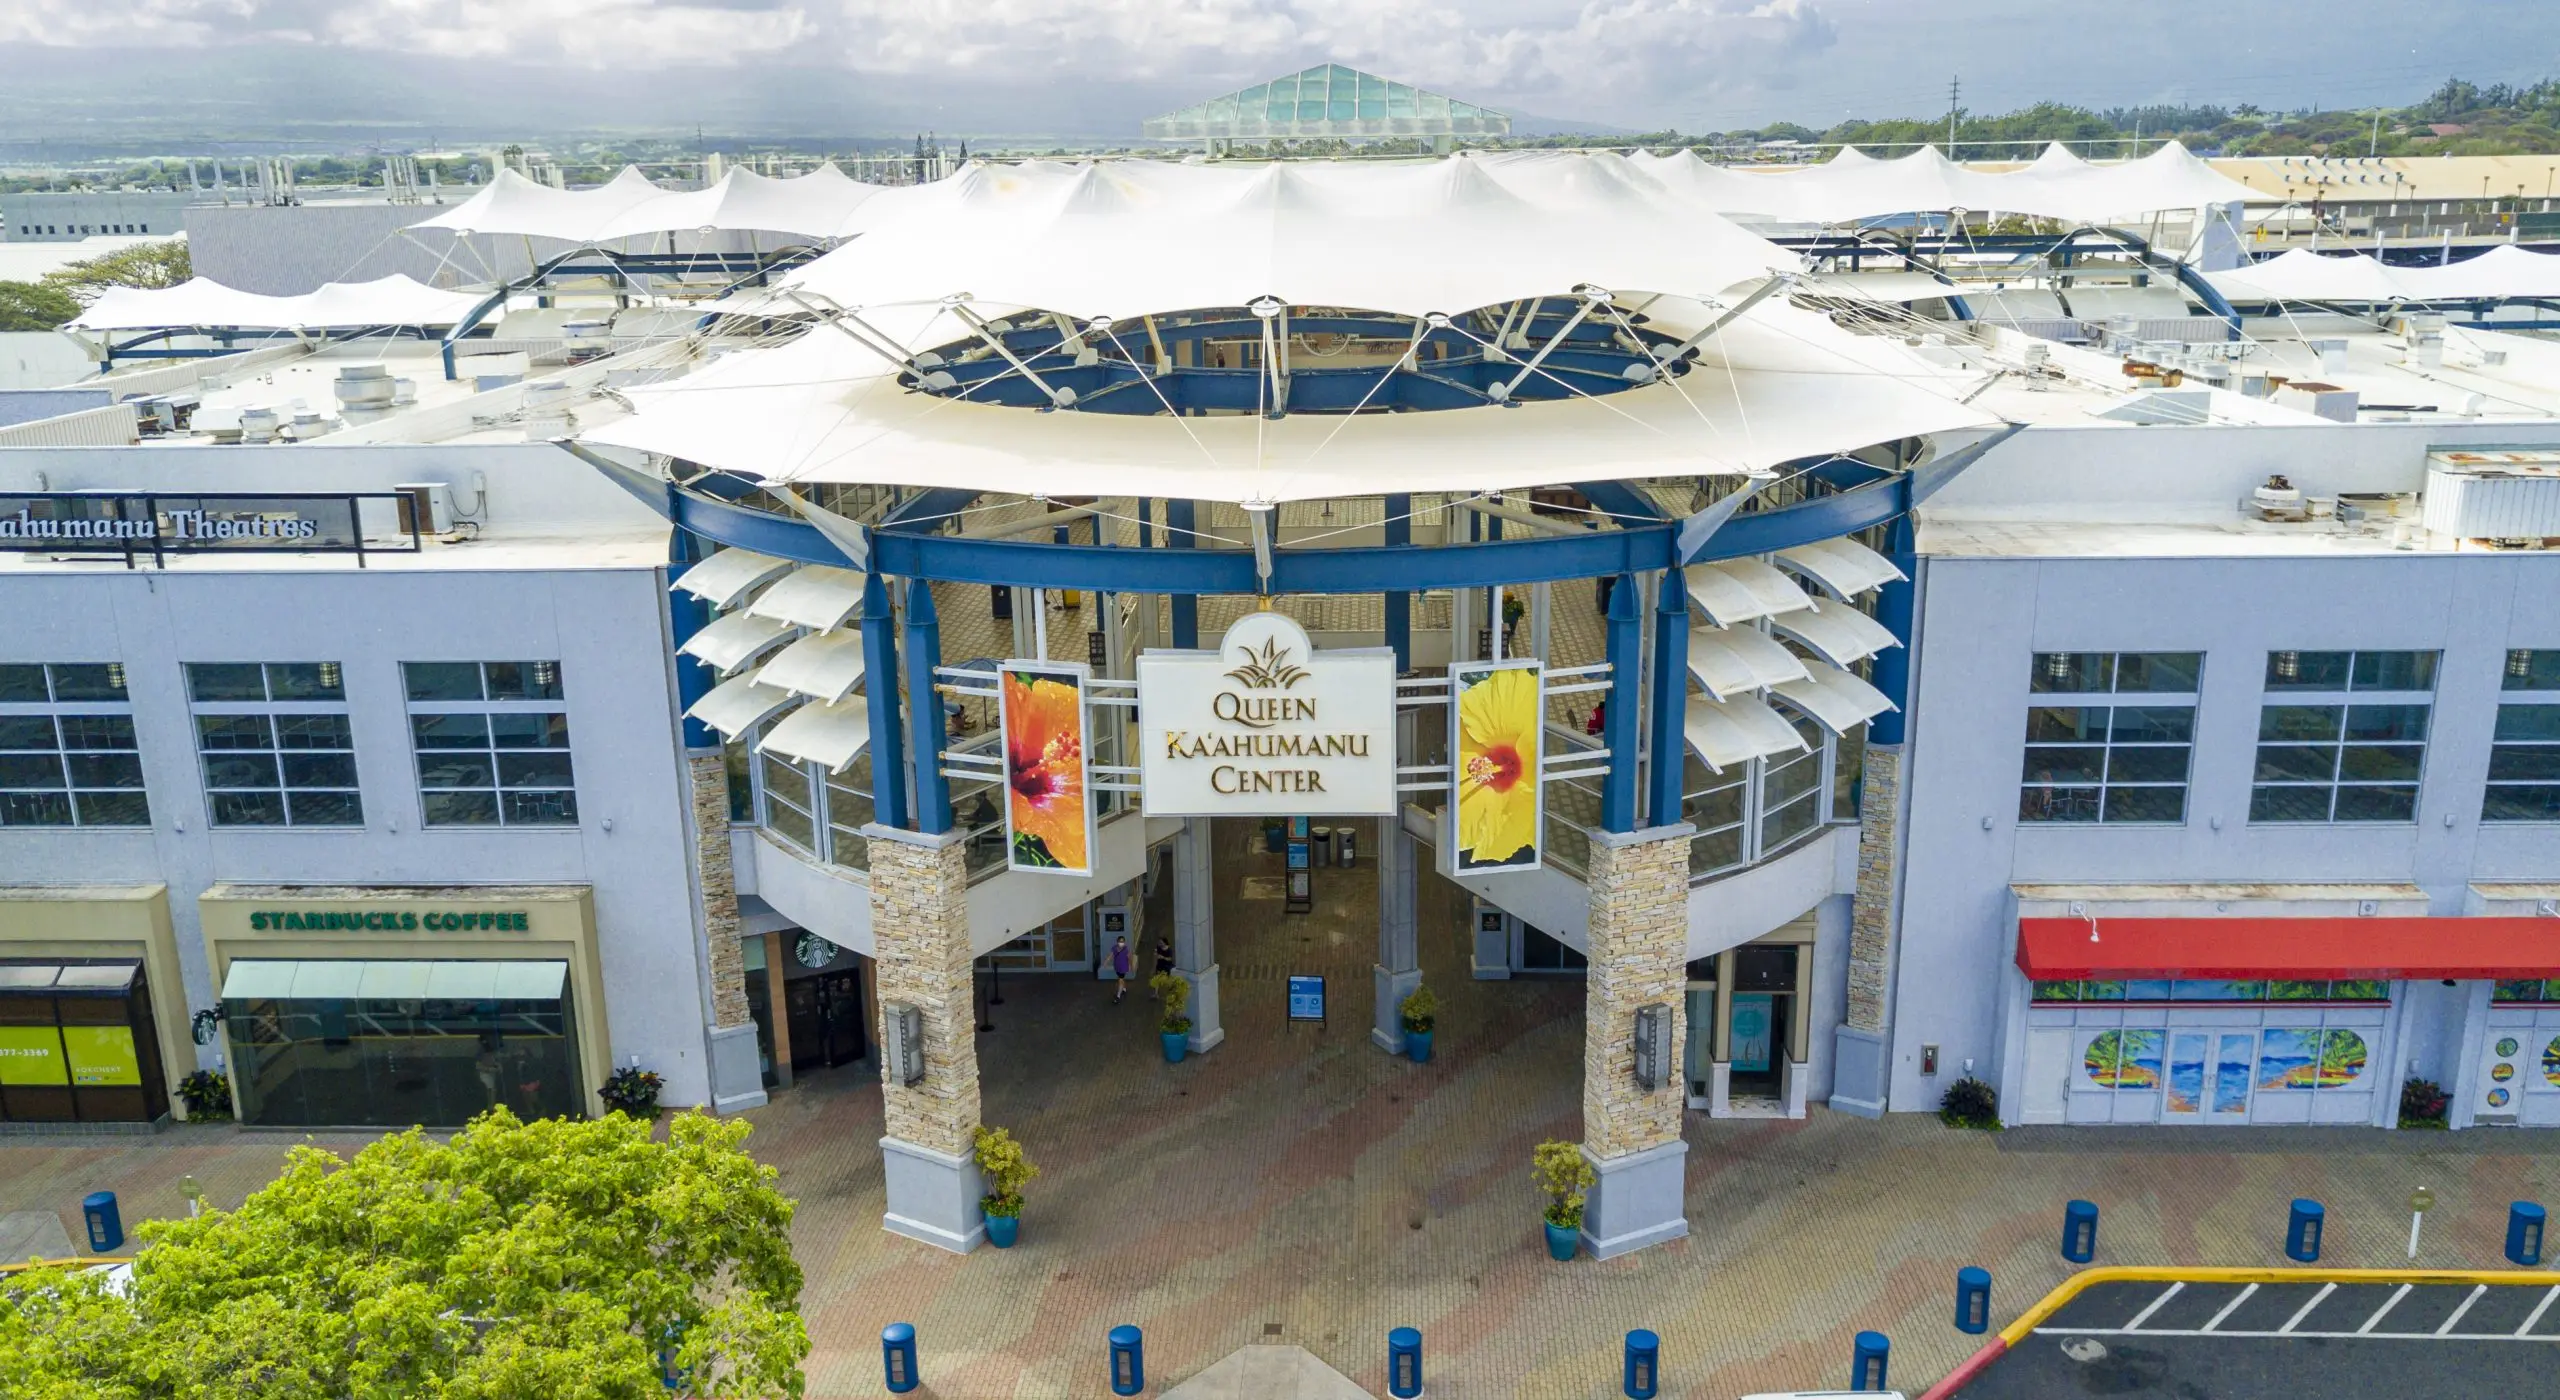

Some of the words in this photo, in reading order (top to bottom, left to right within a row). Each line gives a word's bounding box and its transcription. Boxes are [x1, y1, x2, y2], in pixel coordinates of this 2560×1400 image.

[0, 509, 156, 538] ahumanu
[168, 509, 317, 539] Theatres
[1213, 692, 1317, 728] QUEEN
[1211, 765, 1327, 794] CENTER
[250, 911, 418, 932] STARBUCKS
[423, 911, 529, 932] COFFEE
